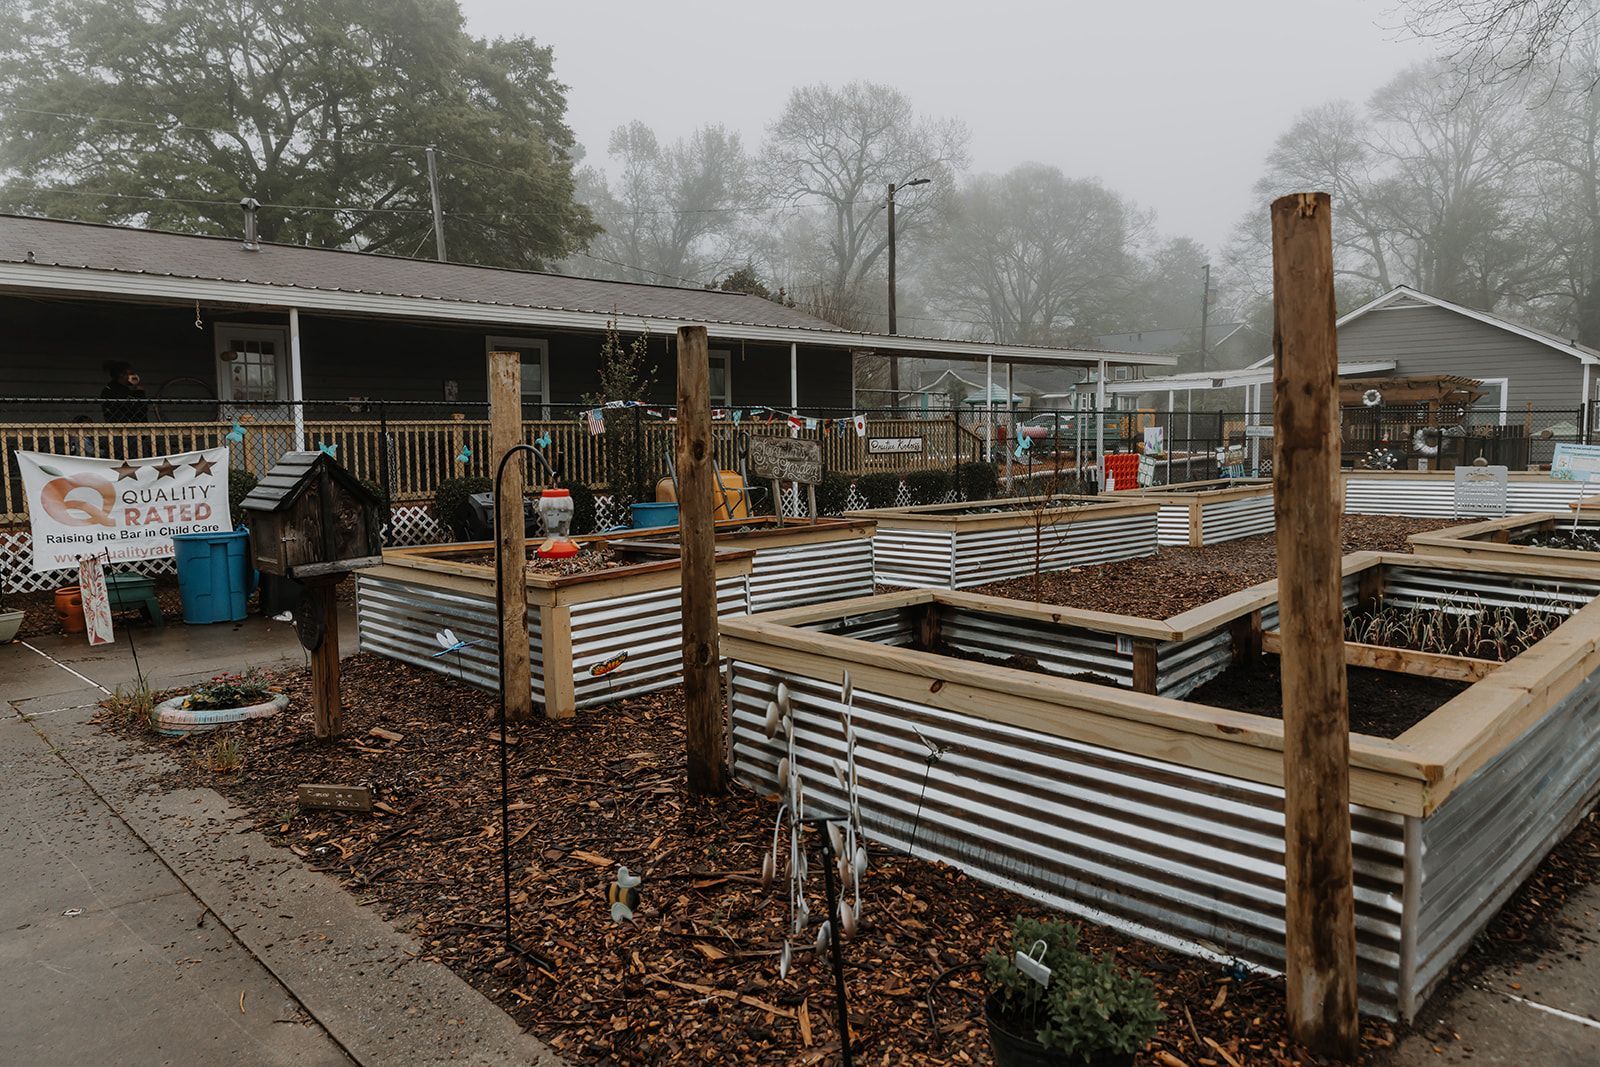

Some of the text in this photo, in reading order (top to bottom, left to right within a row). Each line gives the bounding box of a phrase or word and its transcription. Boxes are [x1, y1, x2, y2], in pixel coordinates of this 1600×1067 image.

[124, 502, 213, 527] RATED
[46, 523, 220, 544] Raising the Bar in Child Care
